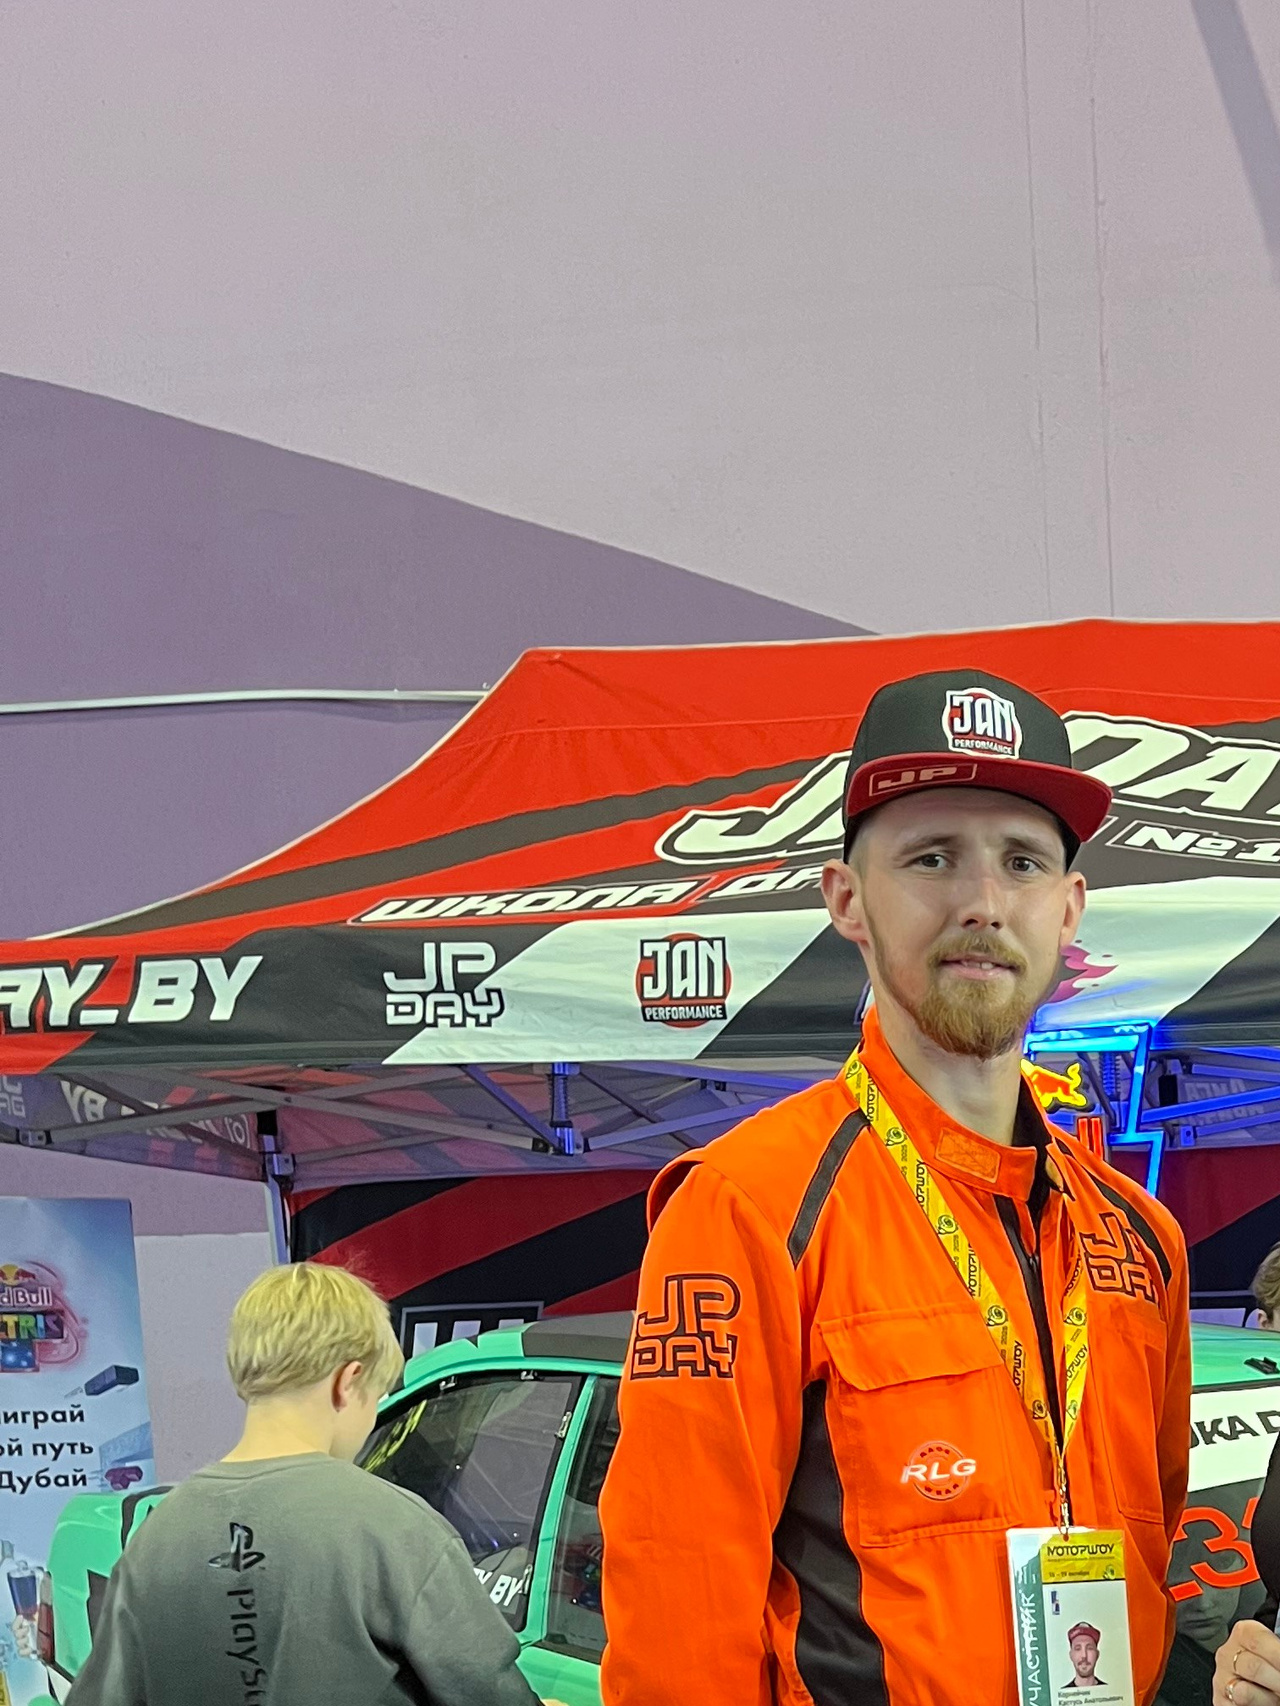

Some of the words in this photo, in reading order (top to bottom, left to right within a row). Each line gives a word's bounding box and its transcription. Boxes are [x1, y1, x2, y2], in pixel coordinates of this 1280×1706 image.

[952, 696, 1014, 742] JAN
[954, 739, 1012, 754] PERFORMANCE
[878, 767, 957, 789] JP
[658, 750, 846, 864] J
[361, 880, 702, 922] ШКОЛА
[382, 942, 500, 993] JP
[642, 937, 726, 1000] JAN
[386, 988, 503, 1028] DAY
[644, 1003, 725, 1022] PERFORMANCE
[1085, 1252, 1157, 1303] DA
[639, 1274, 740, 1336] JP
[631, 1334, 736, 1379] DAY
[33, 1442, 93, 1461] путь
[900, 1459, 976, 1484] RLG
